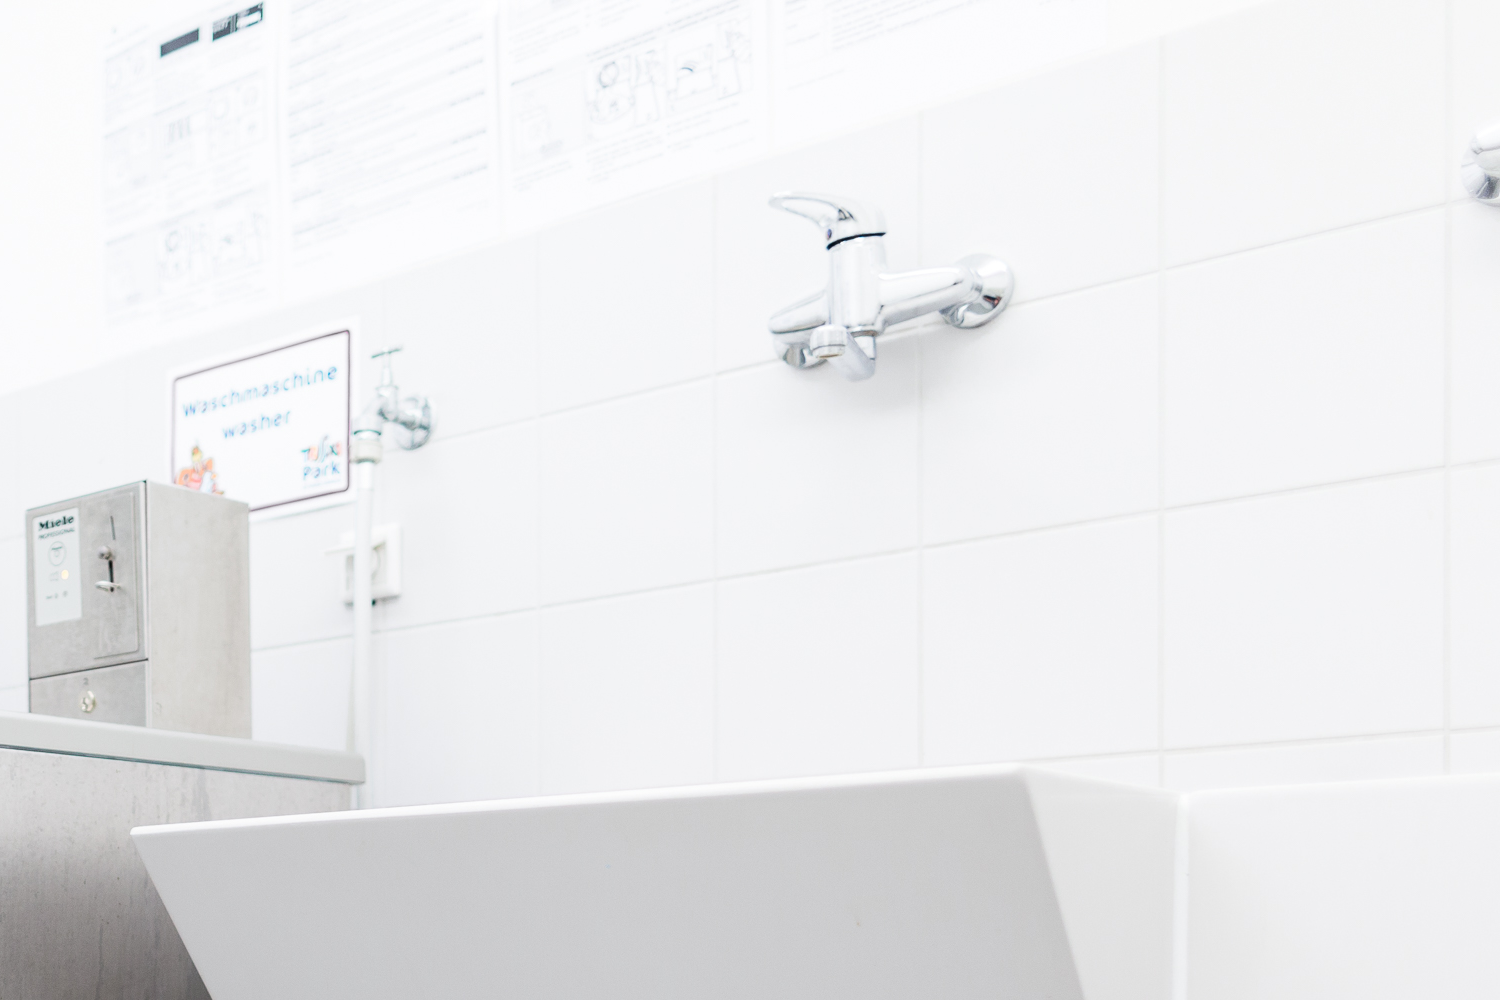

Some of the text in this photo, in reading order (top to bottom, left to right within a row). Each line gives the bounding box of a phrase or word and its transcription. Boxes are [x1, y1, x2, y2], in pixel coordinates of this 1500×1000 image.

[182, 365, 338, 418] Waschmaschine
[222, 409, 291, 439] washer
[38, 515, 75, 531] Miele
